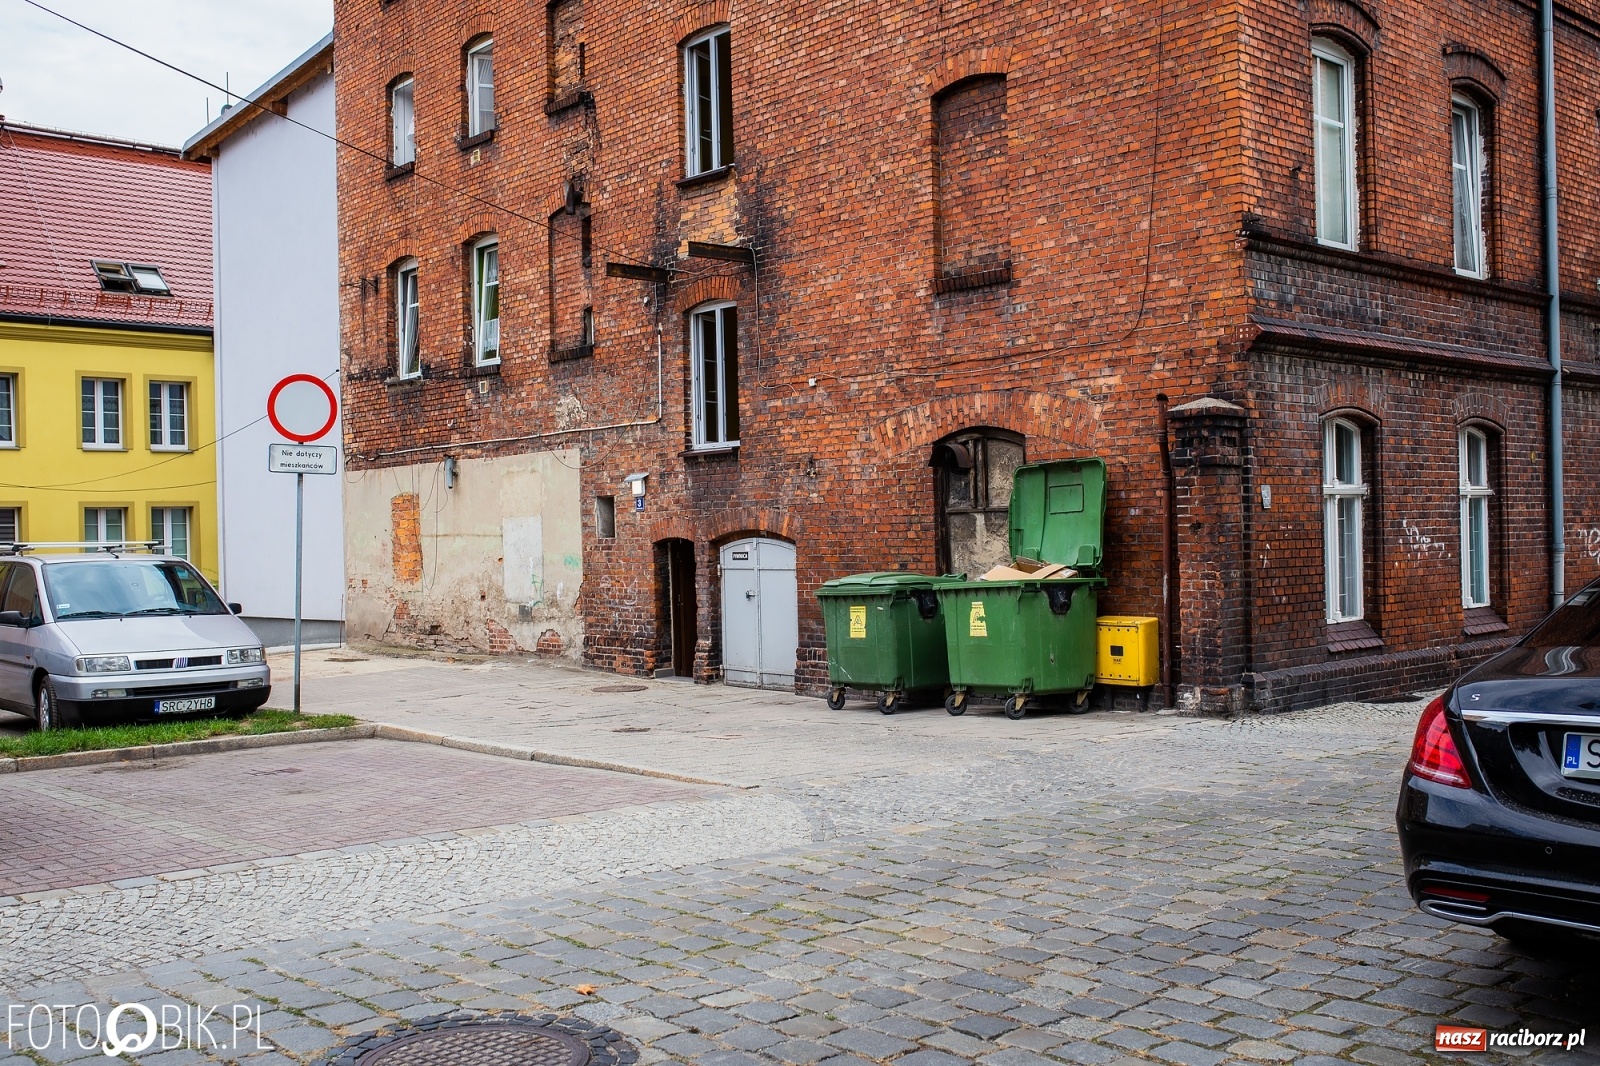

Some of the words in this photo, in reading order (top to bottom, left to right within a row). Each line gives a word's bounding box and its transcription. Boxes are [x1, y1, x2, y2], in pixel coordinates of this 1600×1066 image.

[296, 450, 323, 459] dotyczy
[280, 461, 323, 469] mieszkańców
[637, 499, 642, 507] 3
[162, 701, 183, 712] SRC
[186, 698, 213, 710] 2YH8
[1566, 756, 1578, 765] PL
